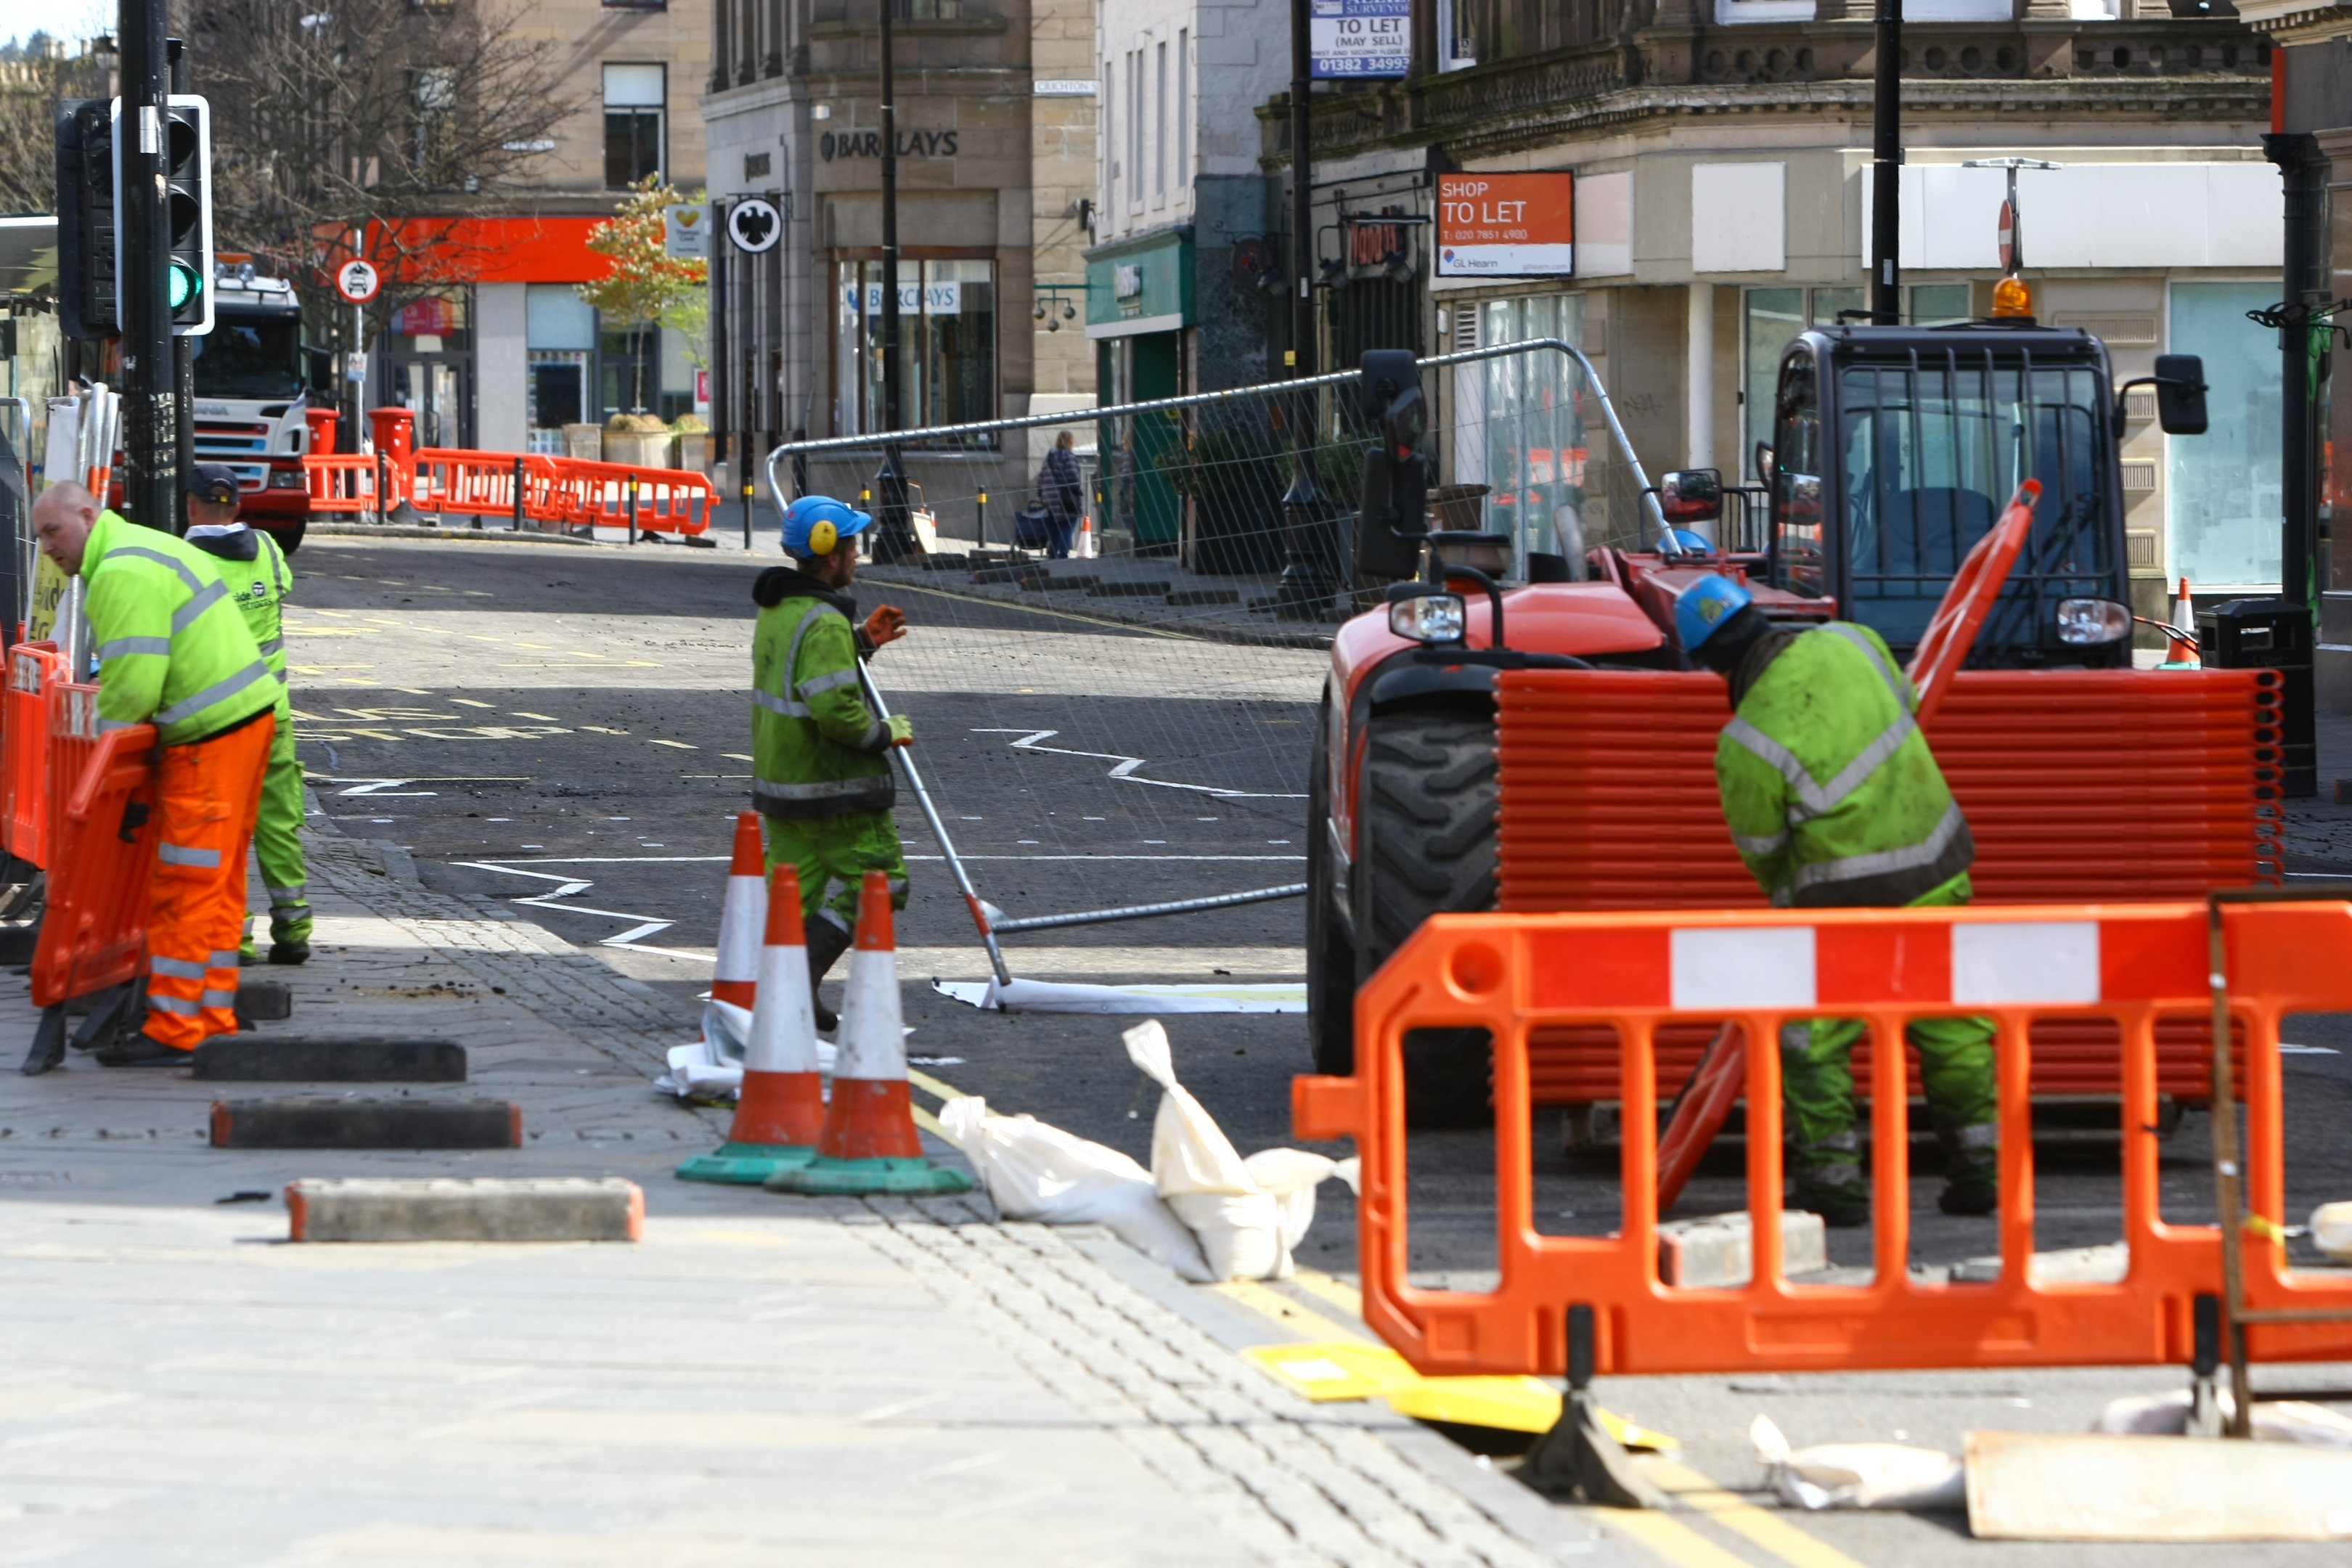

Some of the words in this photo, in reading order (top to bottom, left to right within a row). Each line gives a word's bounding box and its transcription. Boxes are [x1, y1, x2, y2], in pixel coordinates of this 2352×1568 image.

[1336, 19, 1361, 33] TO
[1370, 18, 1401, 33] LET
[1336, 36, 1365, 47] (MAY
[1372, 35, 1402, 45] SELL)
[1320, 59, 1362, 71] 01382
[838, 131, 958, 157] BARLAYS
[1442, 182, 1488, 197] SHOP
[1443, 202, 1474, 223] TO
[1482, 201, 1527, 223] LET
[1455, 230, 1474, 240] 020
[1453, 259, 1466, 268] GL
[1468, 259, 1498, 268] Hearn
[870, 287, 954, 307] BRCLAYS
